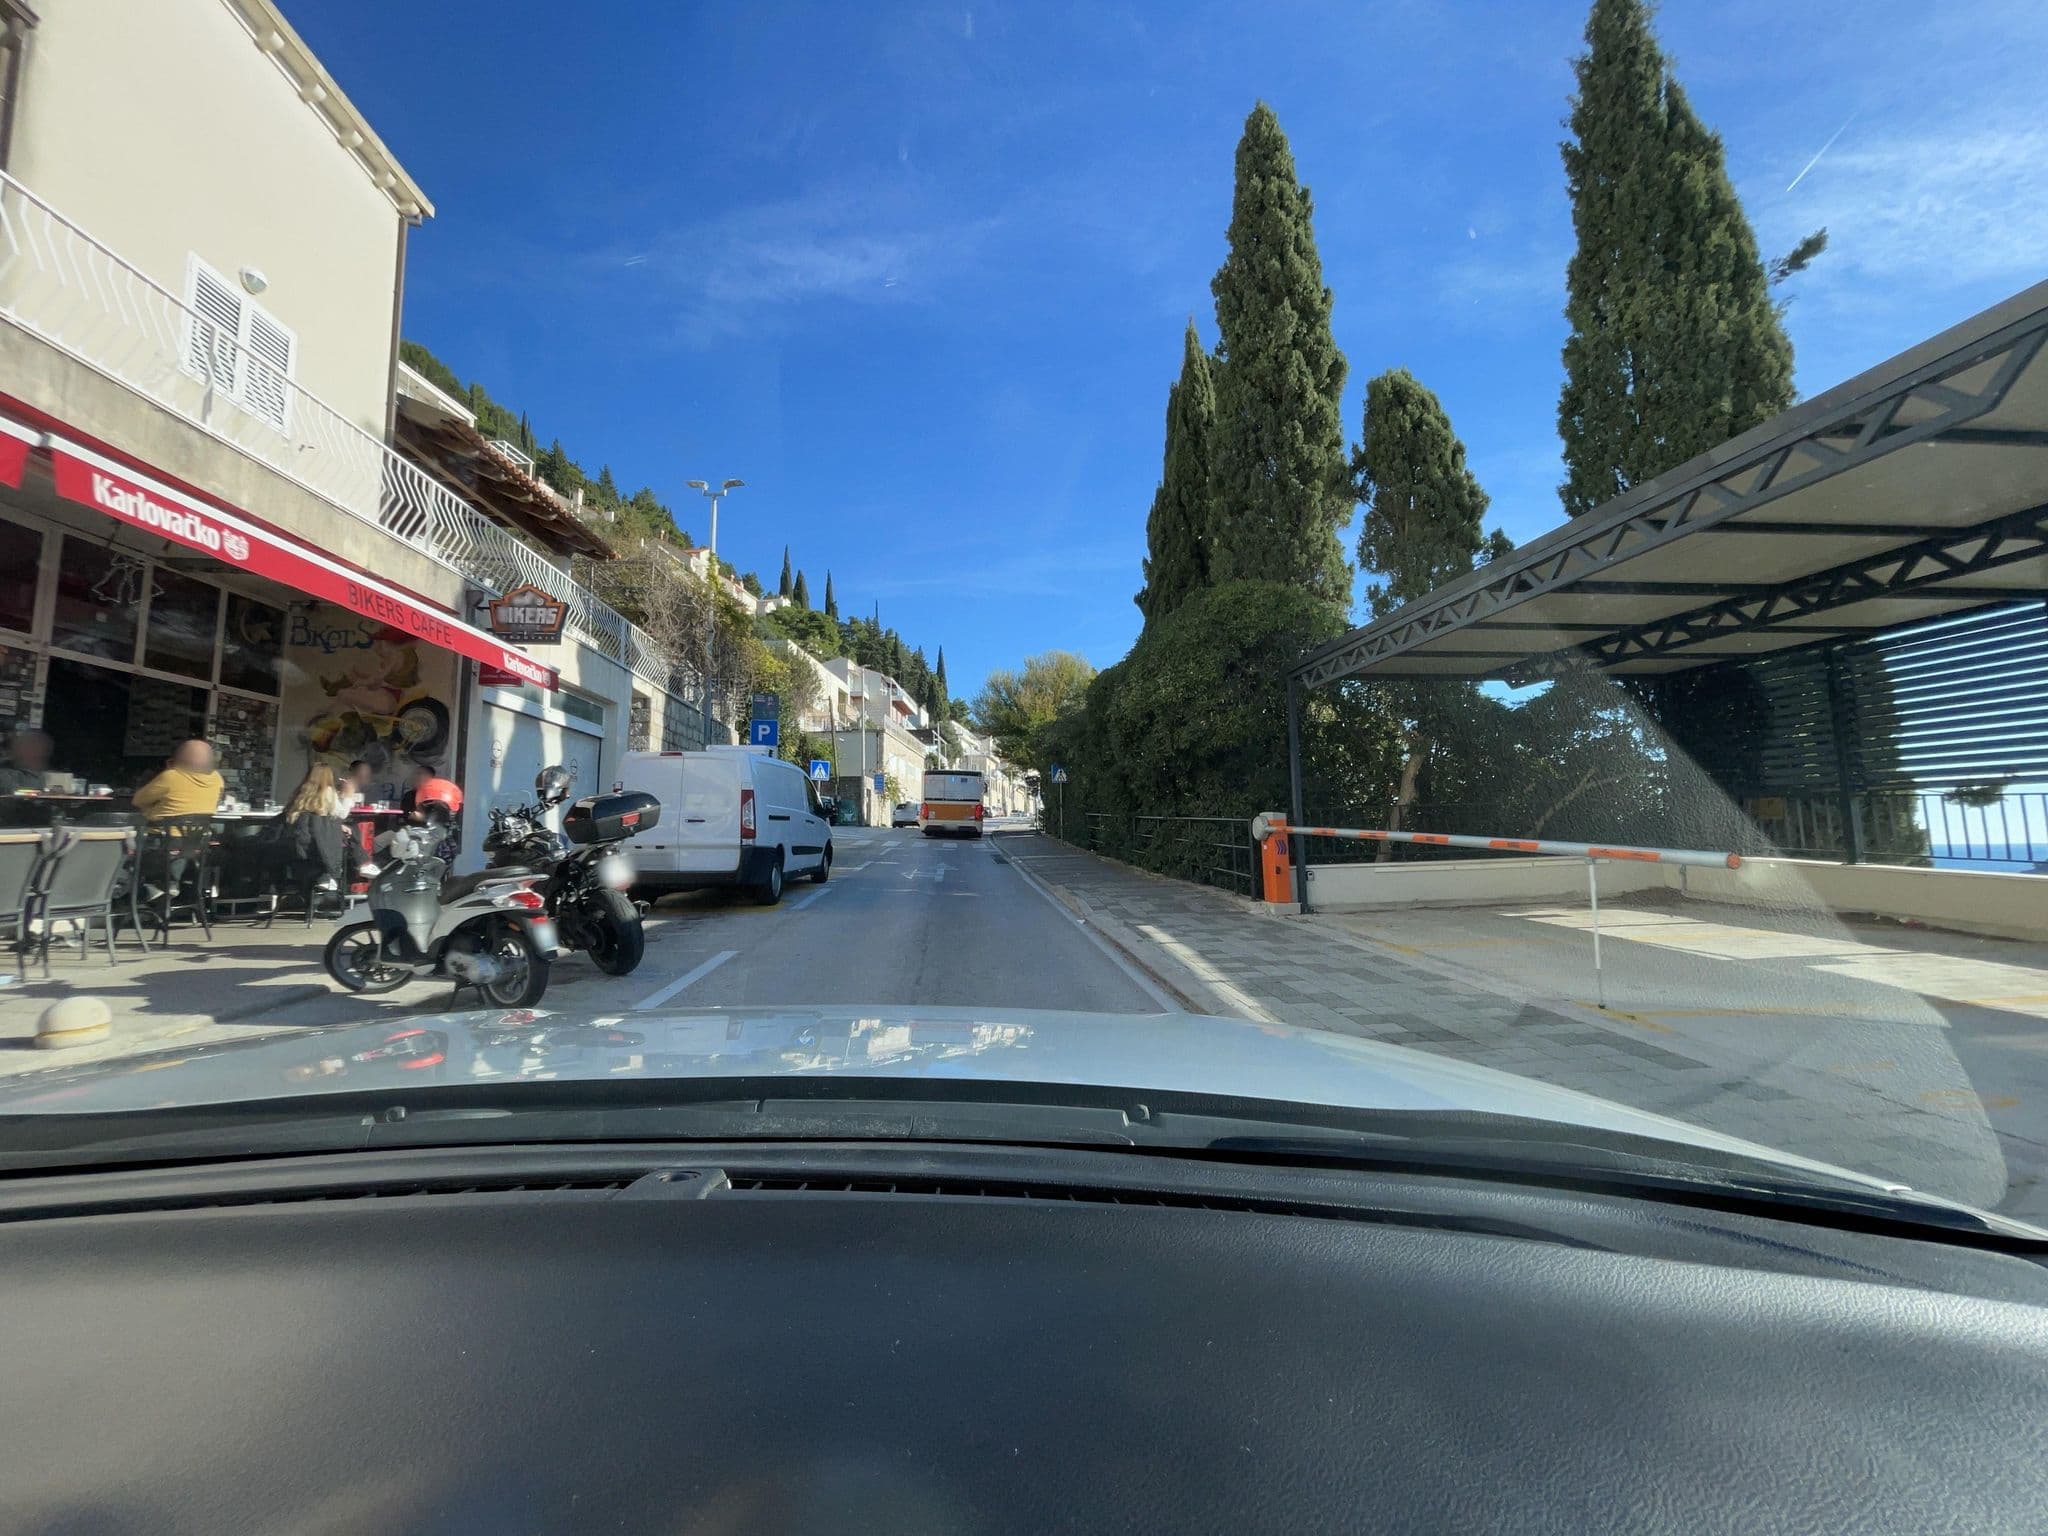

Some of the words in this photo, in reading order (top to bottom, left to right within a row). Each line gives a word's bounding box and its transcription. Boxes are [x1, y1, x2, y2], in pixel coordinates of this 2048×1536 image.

[92, 473, 221, 551] Karlovačko
[348, 584, 404, 625] BIKERS
[410, 611, 452, 645] CAFFE
[758, 724, 771, 741] P
